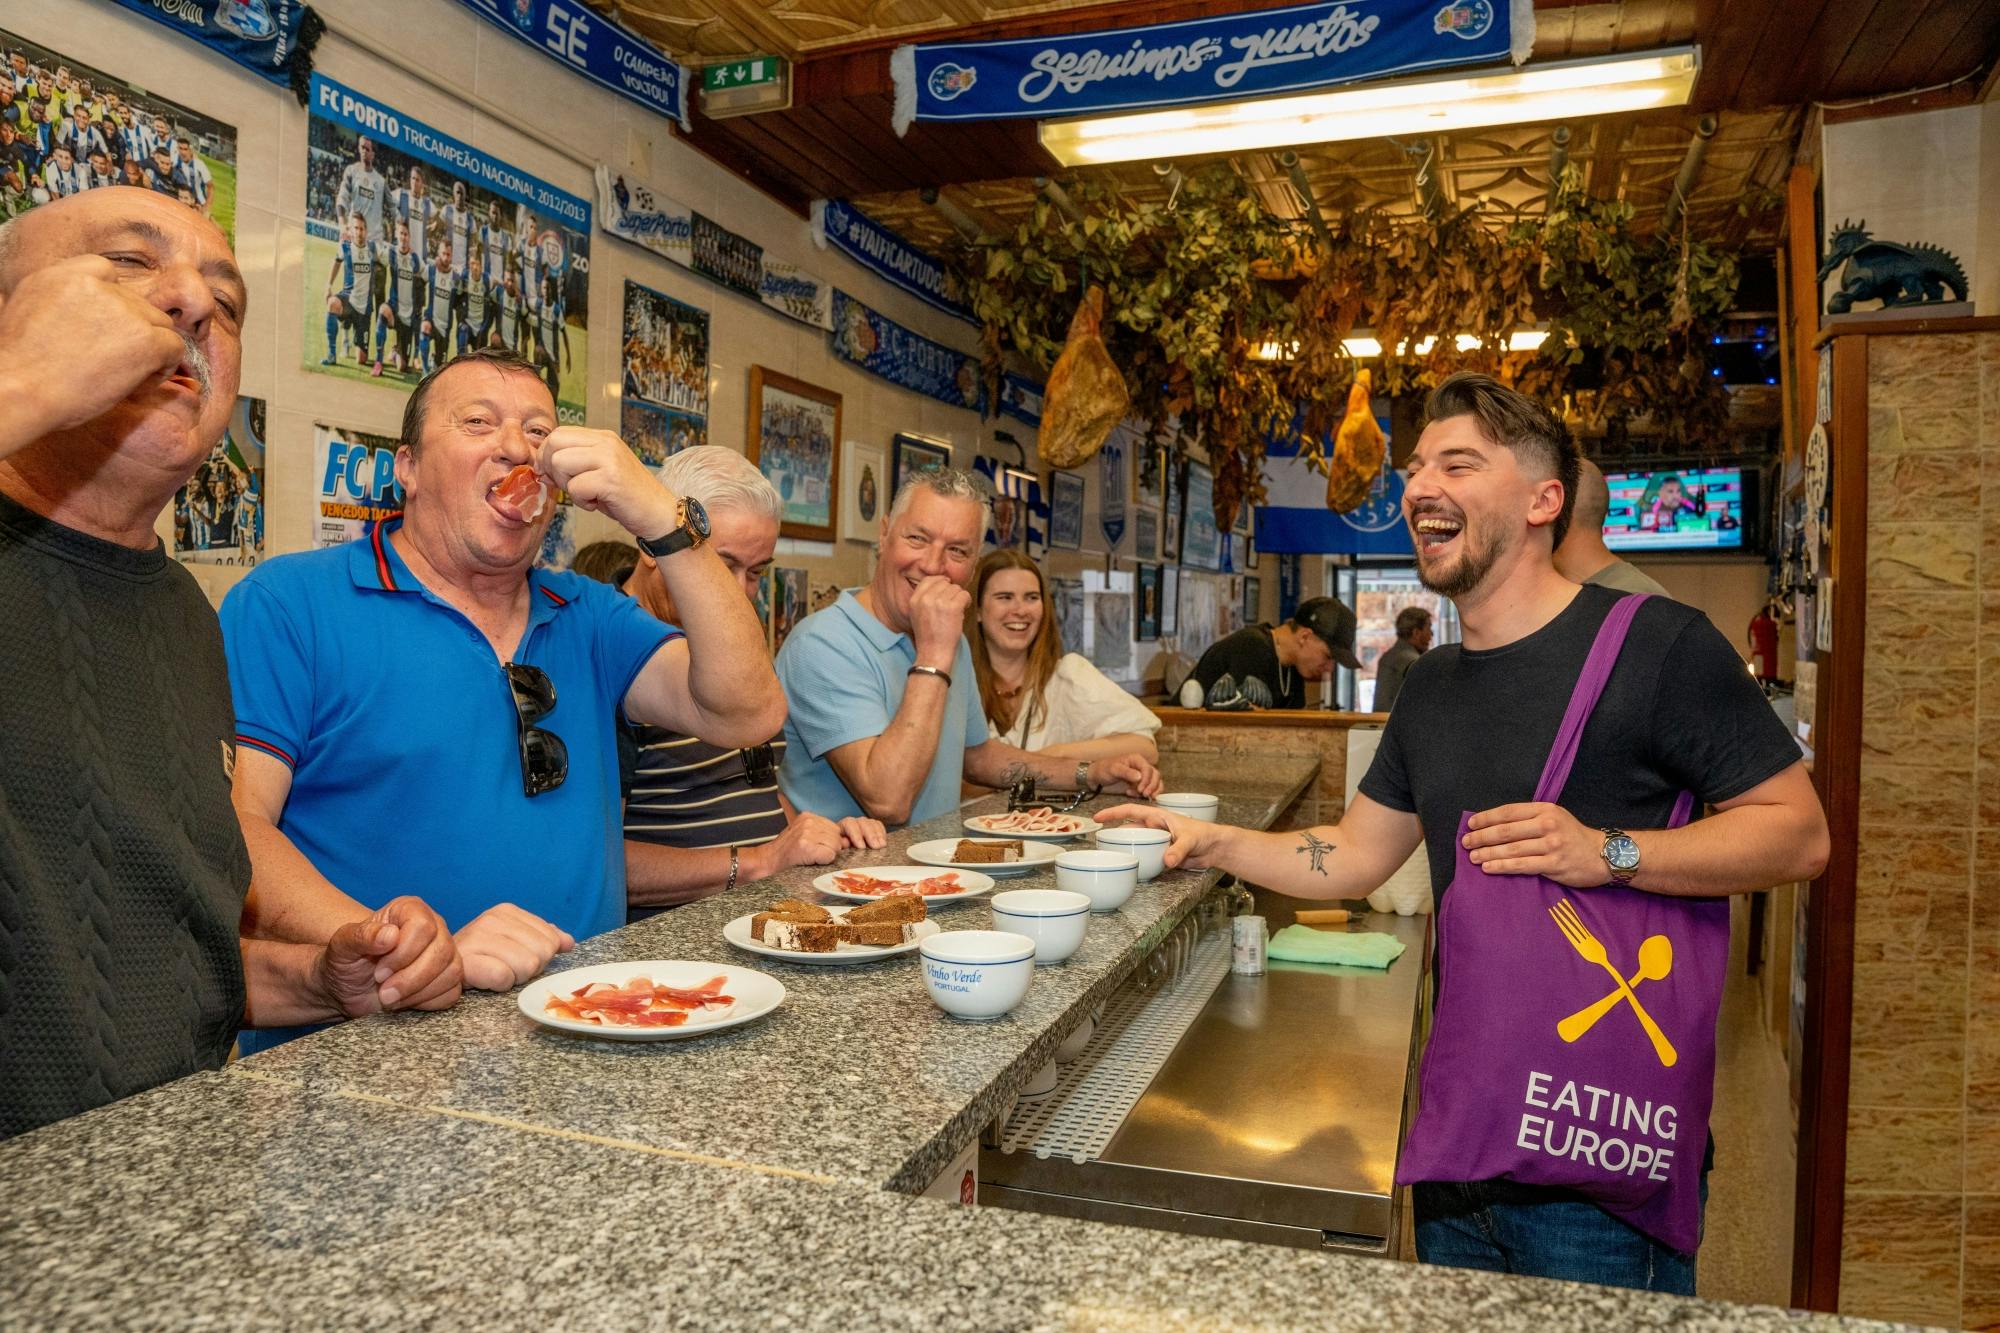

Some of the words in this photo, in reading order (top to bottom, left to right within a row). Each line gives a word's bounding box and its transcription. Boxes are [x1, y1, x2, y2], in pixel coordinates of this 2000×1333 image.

[546, 15, 590, 68] SÉ
[614, 46, 623, 62] O
[623, 51, 675, 88] CAMPEÃO
[621, 72, 669, 105] VOLTOU!
[1018, 37, 1222, 103] Seguimos
[320, 83, 339, 112] FC
[342, 94, 399, 138] PORTO
[402, 124, 480, 174] TRICAMPEÃO
[481, 162, 536, 200] NACIONAL
[537, 188, 587, 222] 2012/2013
[850, 222, 950, 298] #VAIFICARTUDO
[908, 336, 954, 379] PORTO
[556, 406, 585, 426] OGO
[322, 441, 368, 499] FC
[320, 502, 370, 521] VENCEDOR
[927, 964, 950, 981] Vinho
[951, 969, 982, 983] Verde
[934, 981, 970, 992] PORTUGAL
[1525, 1071, 1678, 1141] EATING
[1516, 1113, 1675, 1181] EUROPE
